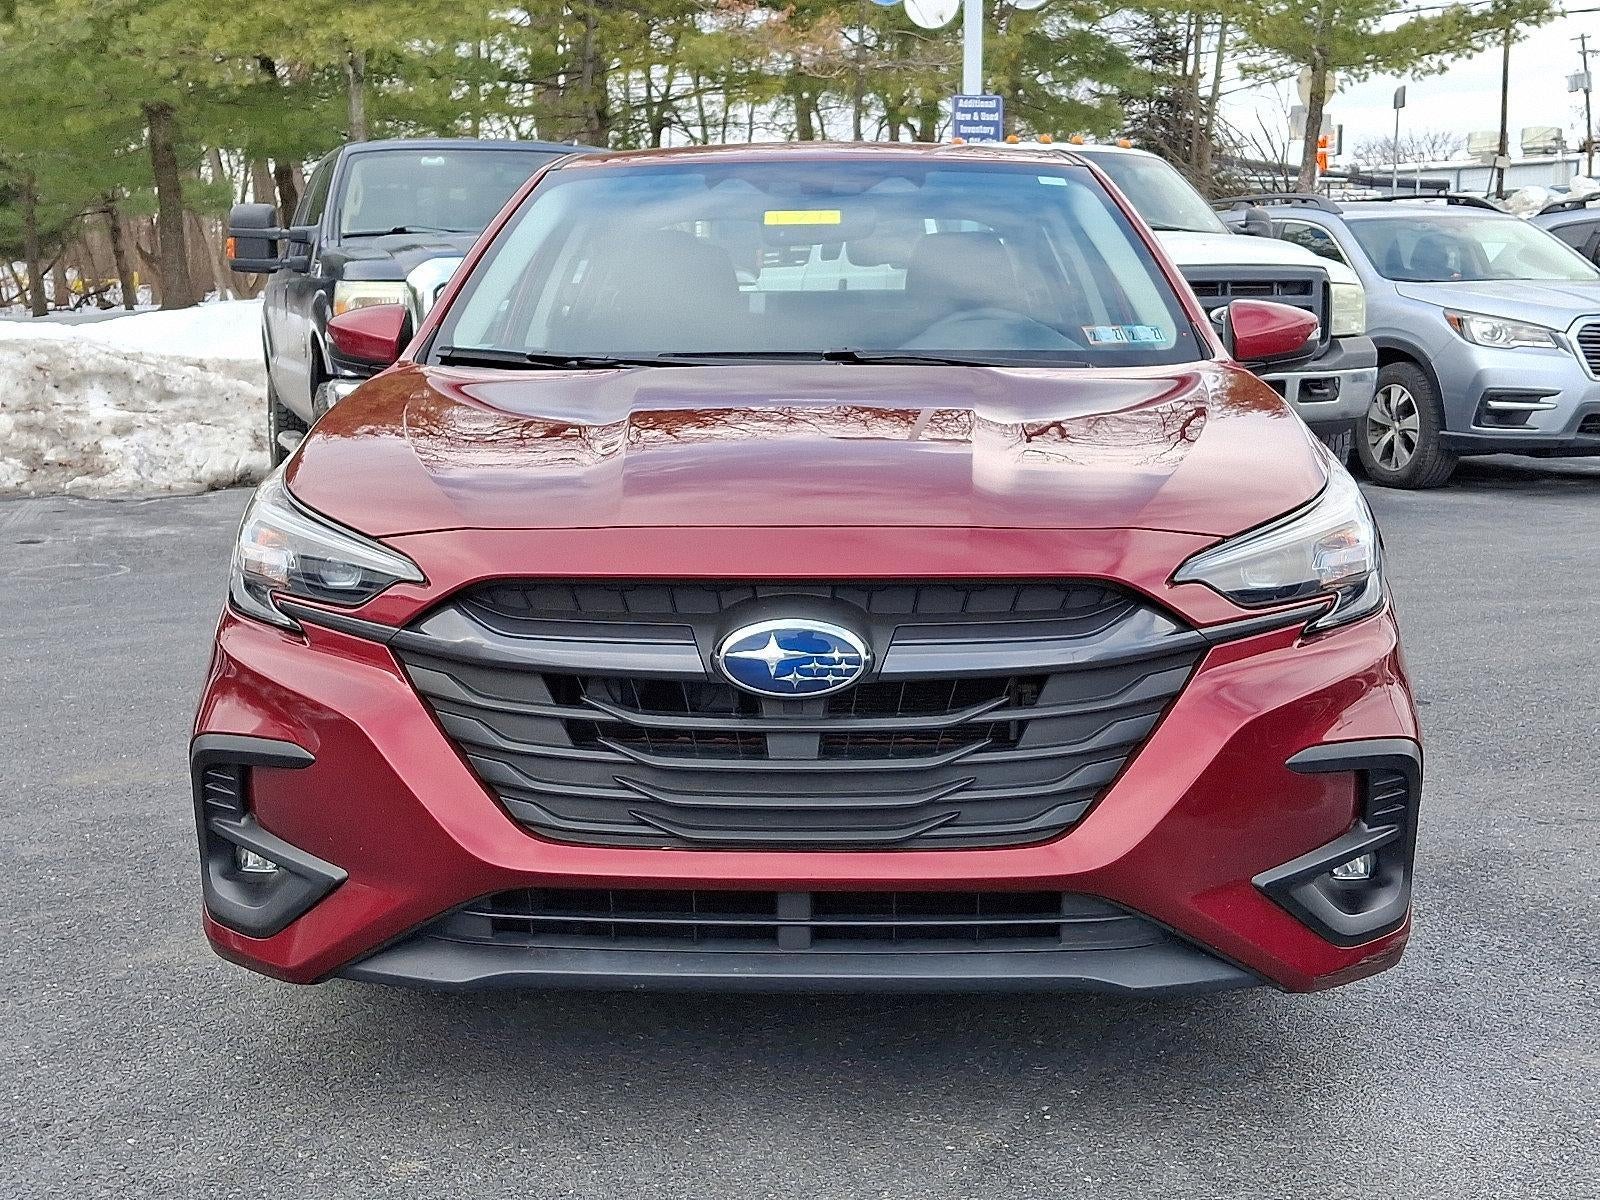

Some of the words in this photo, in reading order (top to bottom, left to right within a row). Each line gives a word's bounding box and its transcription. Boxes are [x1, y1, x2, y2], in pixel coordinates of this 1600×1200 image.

[958, 98, 996, 108] Additional
[955, 111, 972, 121] New
[973, 111, 979, 121] &
[980, 111, 999, 121] Used
[959, 124, 995, 135] Inventory
